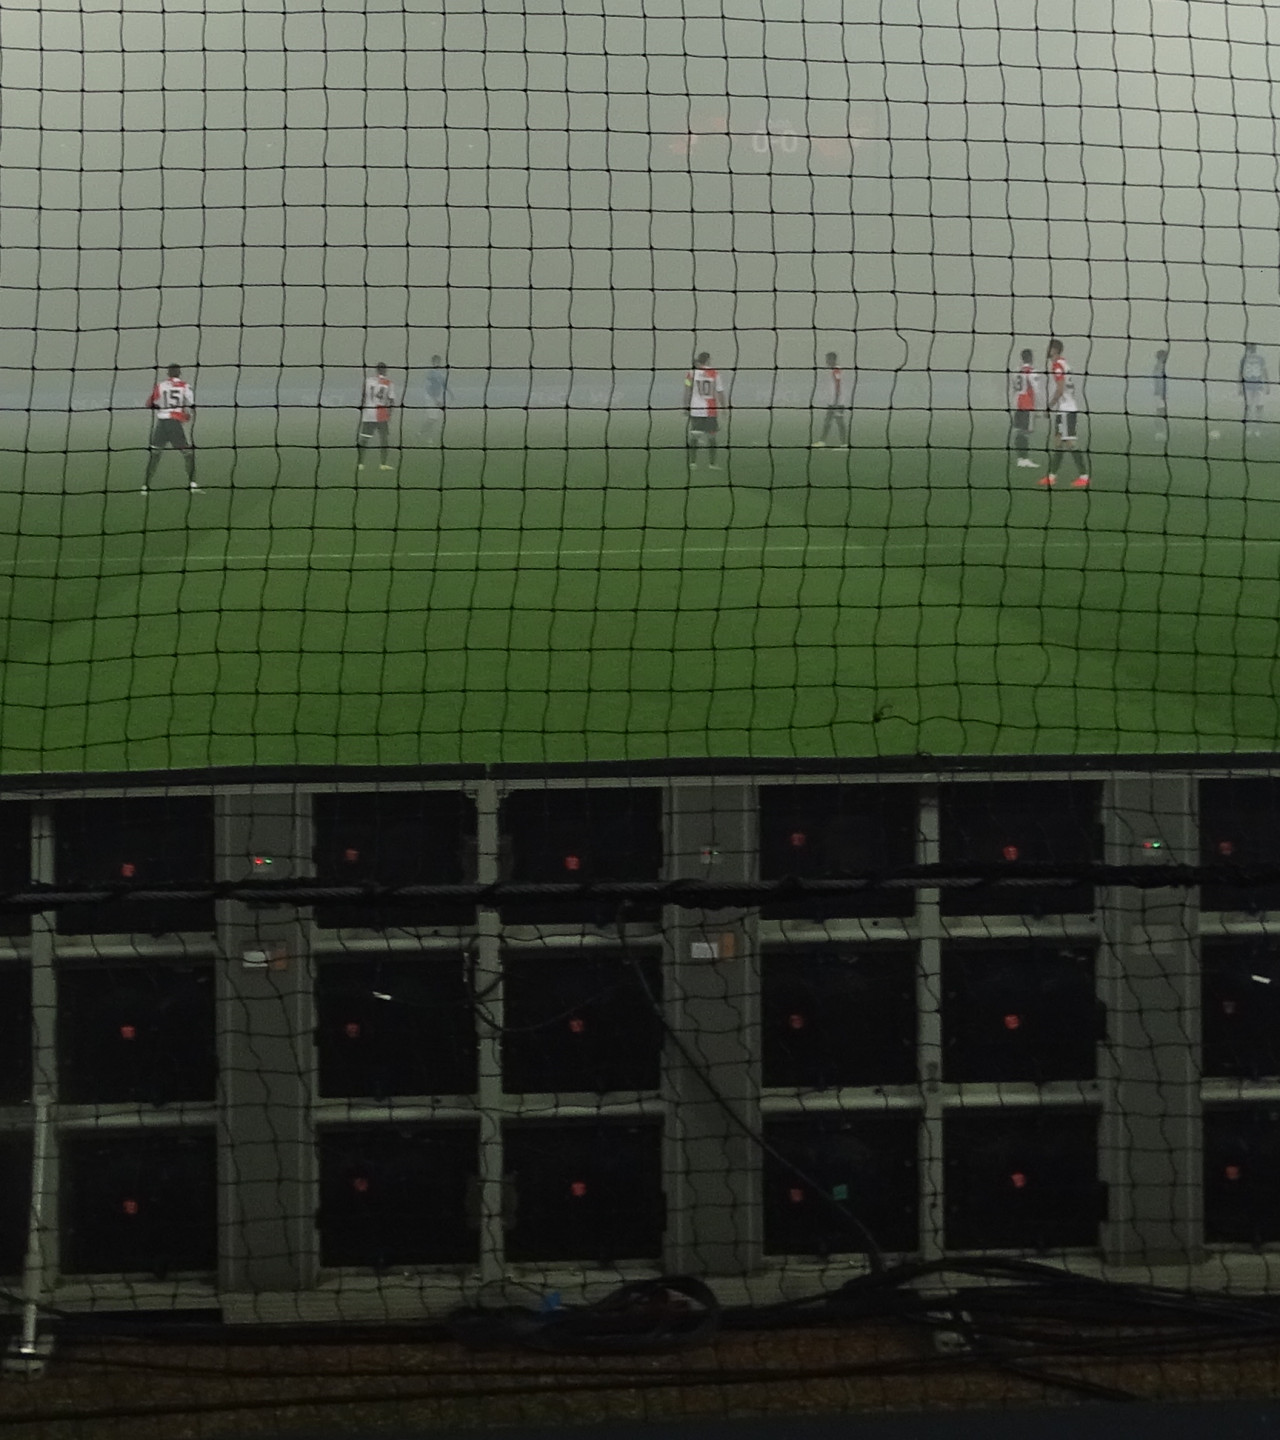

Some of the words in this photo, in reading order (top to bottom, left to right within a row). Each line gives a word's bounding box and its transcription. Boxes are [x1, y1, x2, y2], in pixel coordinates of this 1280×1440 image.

[369, 385, 385, 401] 14
[694, 379, 709, 396] 10
[162, 389, 180, 408] 15
